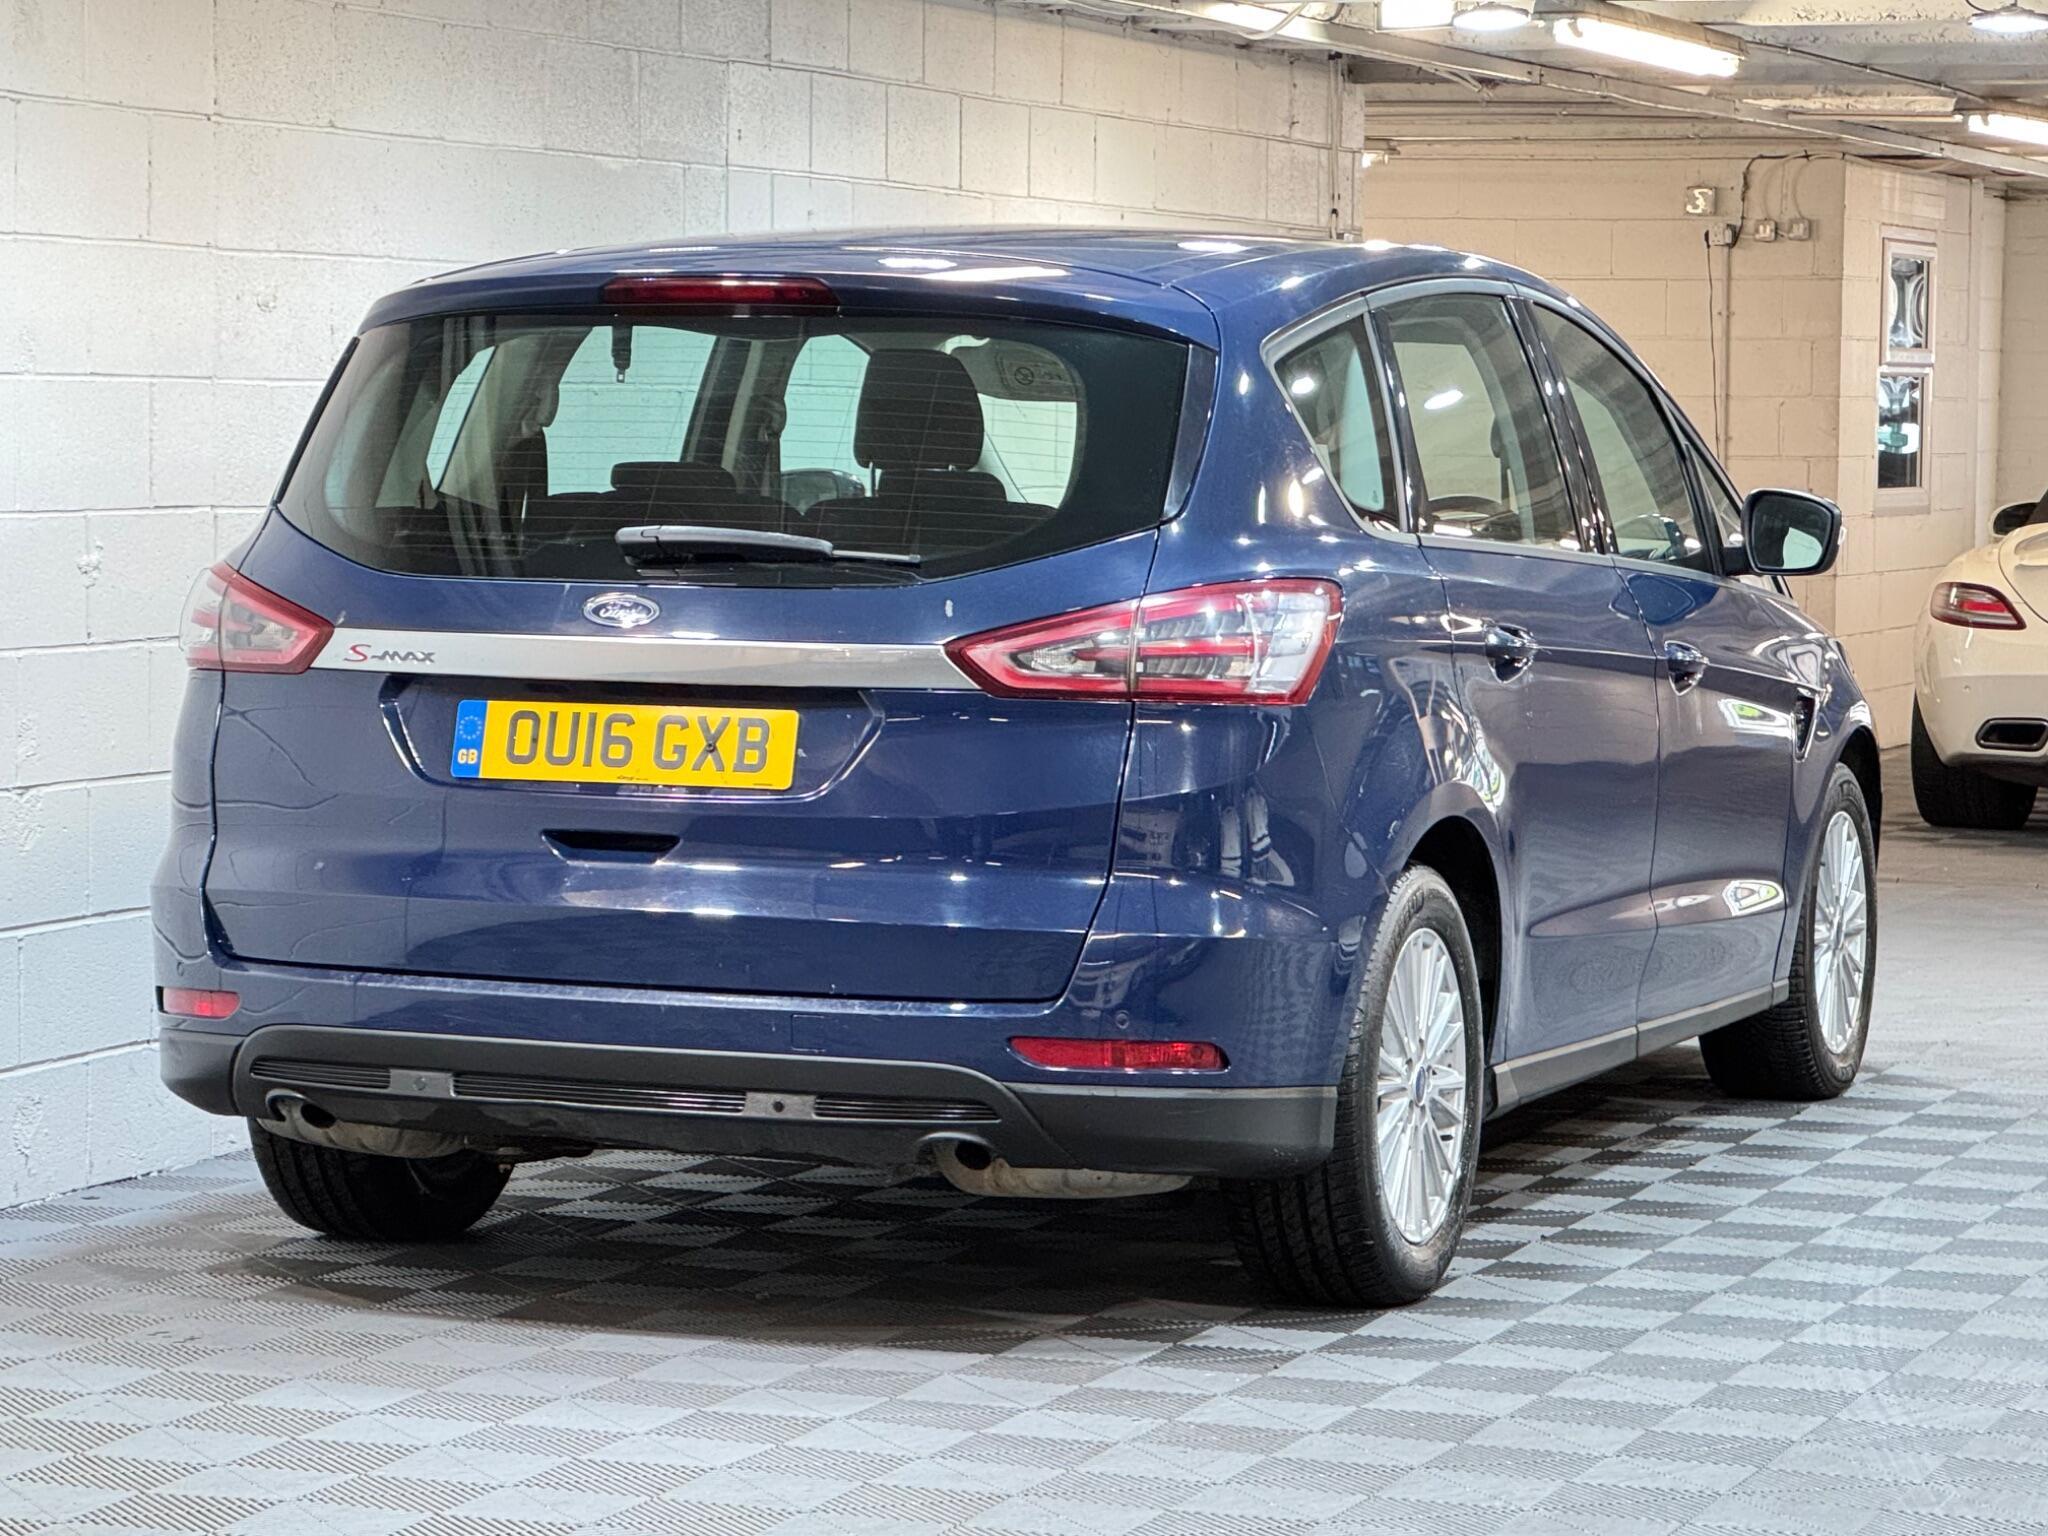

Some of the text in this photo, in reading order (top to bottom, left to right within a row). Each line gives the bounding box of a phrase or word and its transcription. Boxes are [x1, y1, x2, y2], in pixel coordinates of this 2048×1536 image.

[342, 643, 436, 663] S-MAX
[505, 709, 770, 773] OU16 GXB
[456, 748, 478, 765] GB
